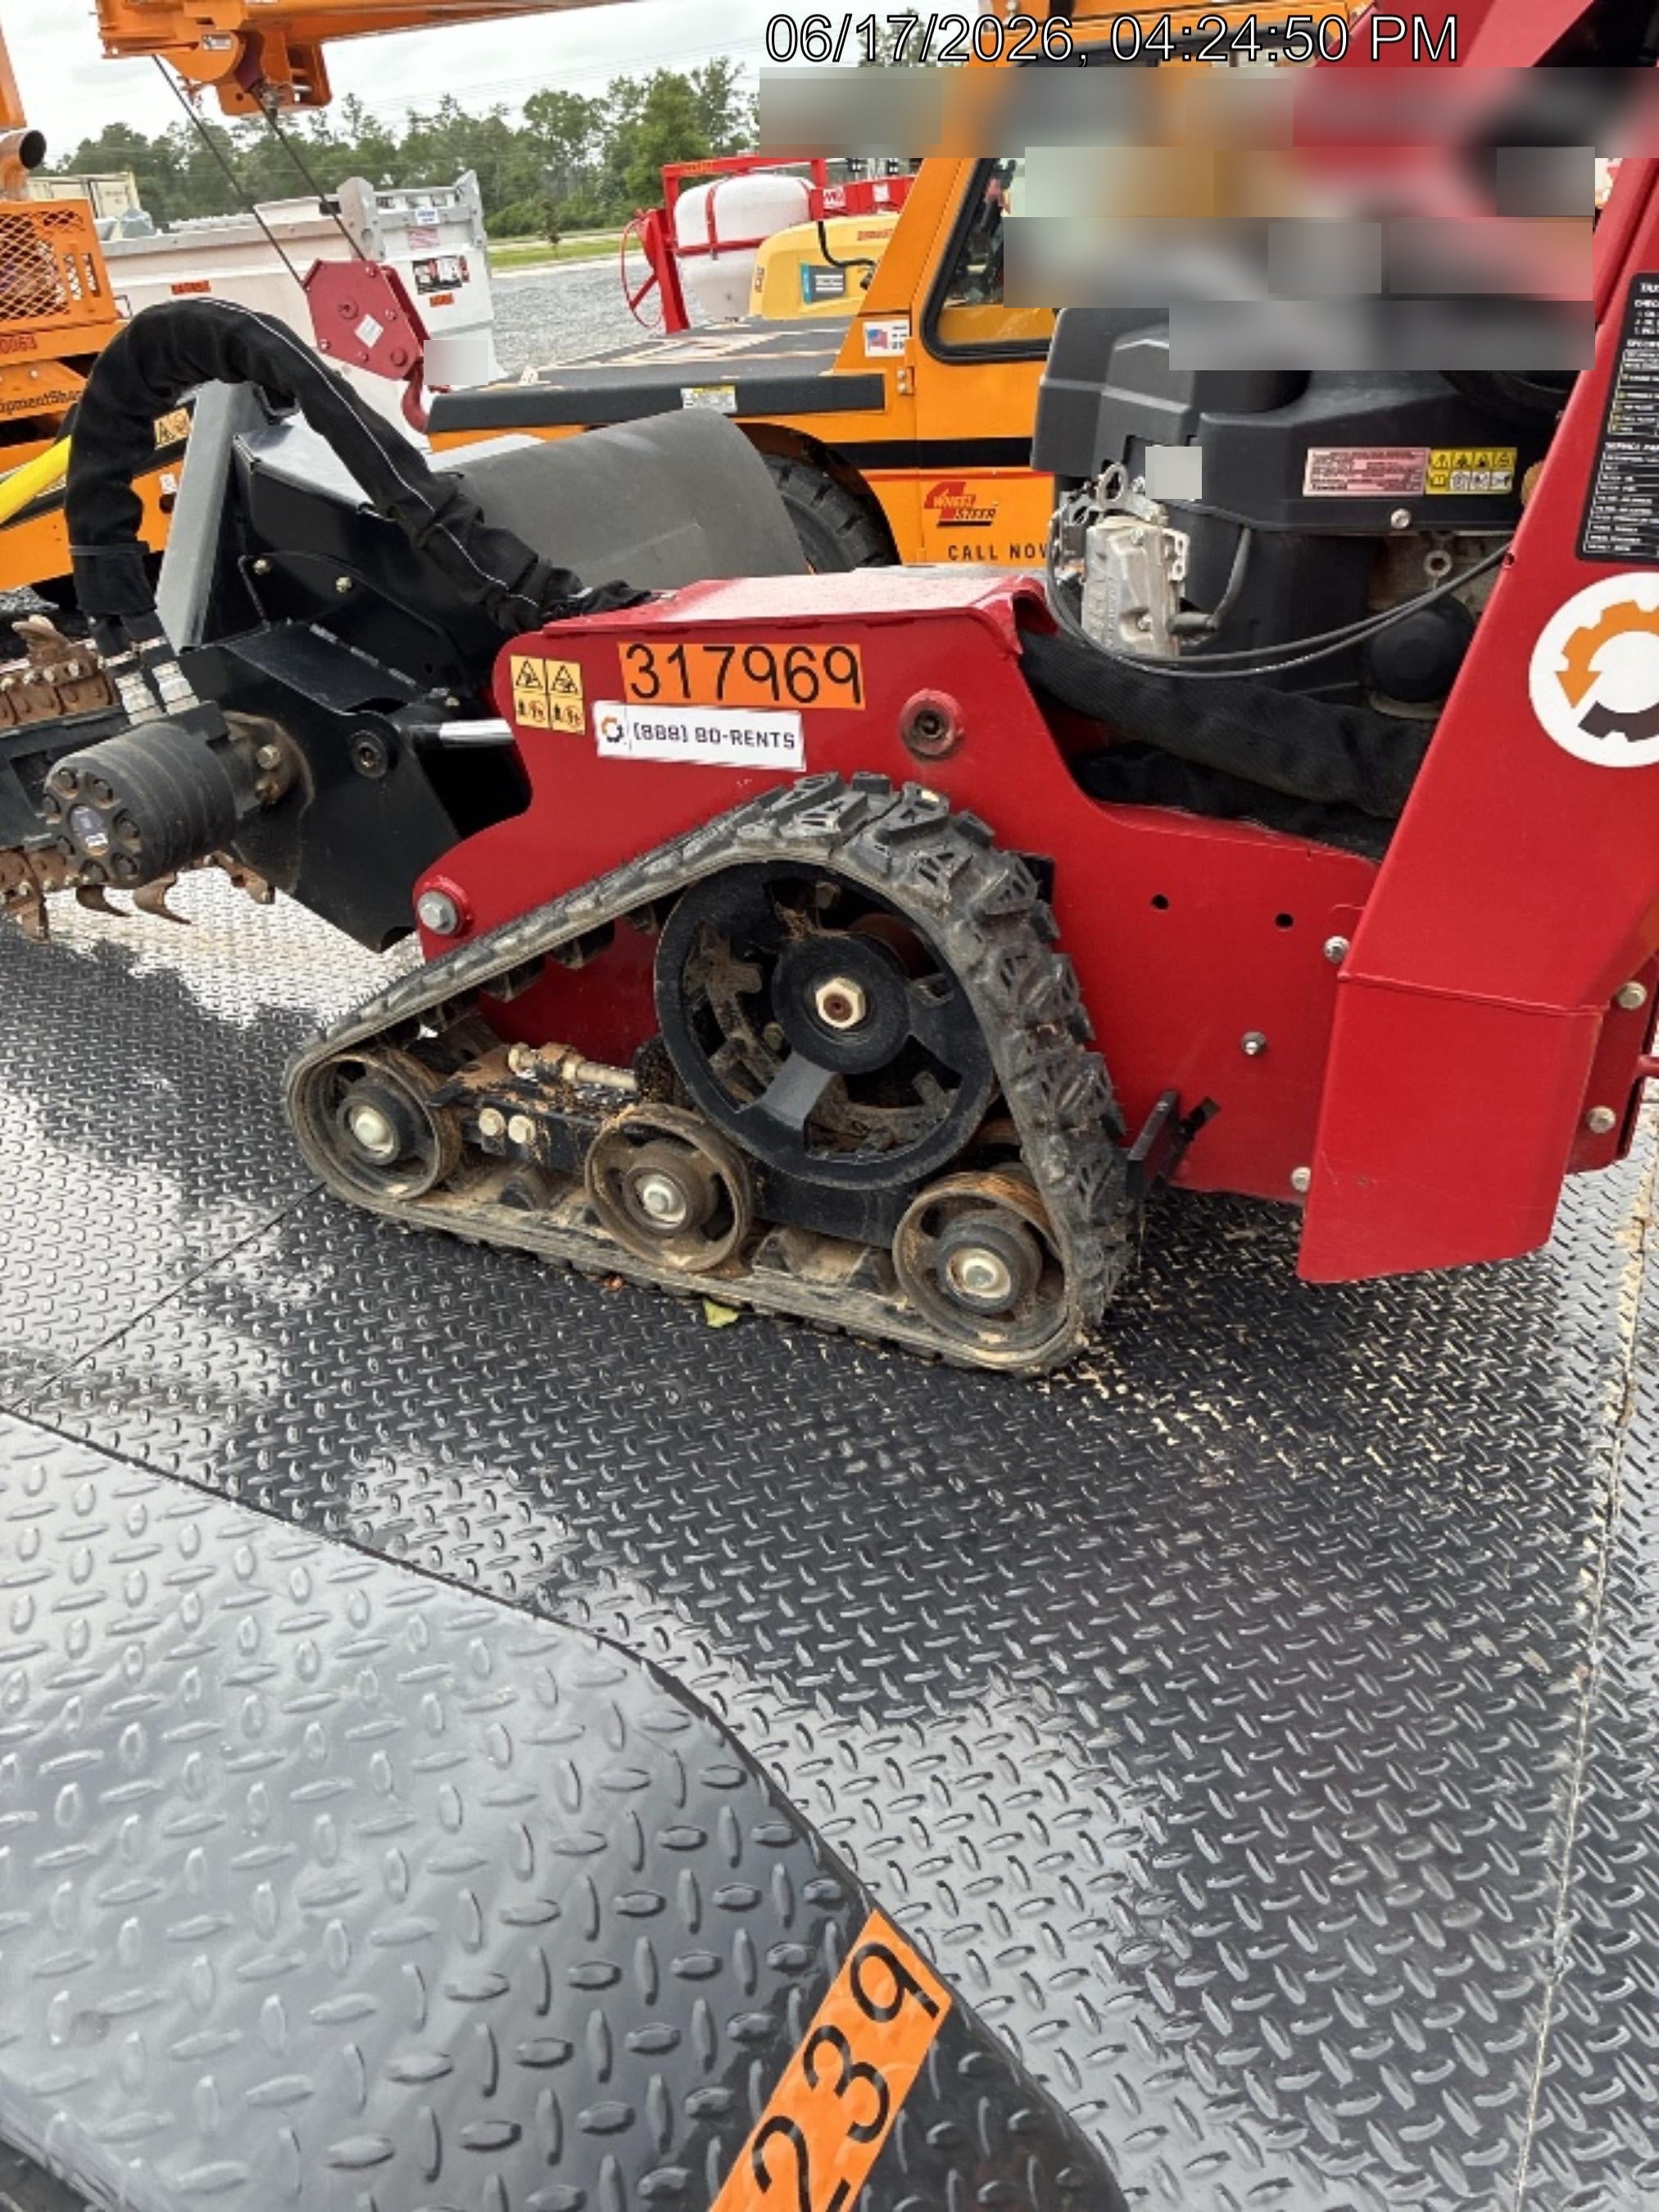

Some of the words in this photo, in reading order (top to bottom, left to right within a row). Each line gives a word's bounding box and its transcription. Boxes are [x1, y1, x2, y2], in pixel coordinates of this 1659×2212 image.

[955, 508, 996, 519] STEER
[948, 544, 998, 561] CALL
[626, 643, 860, 705] 317969
[696, 728, 795, 750] 80-RENTS
